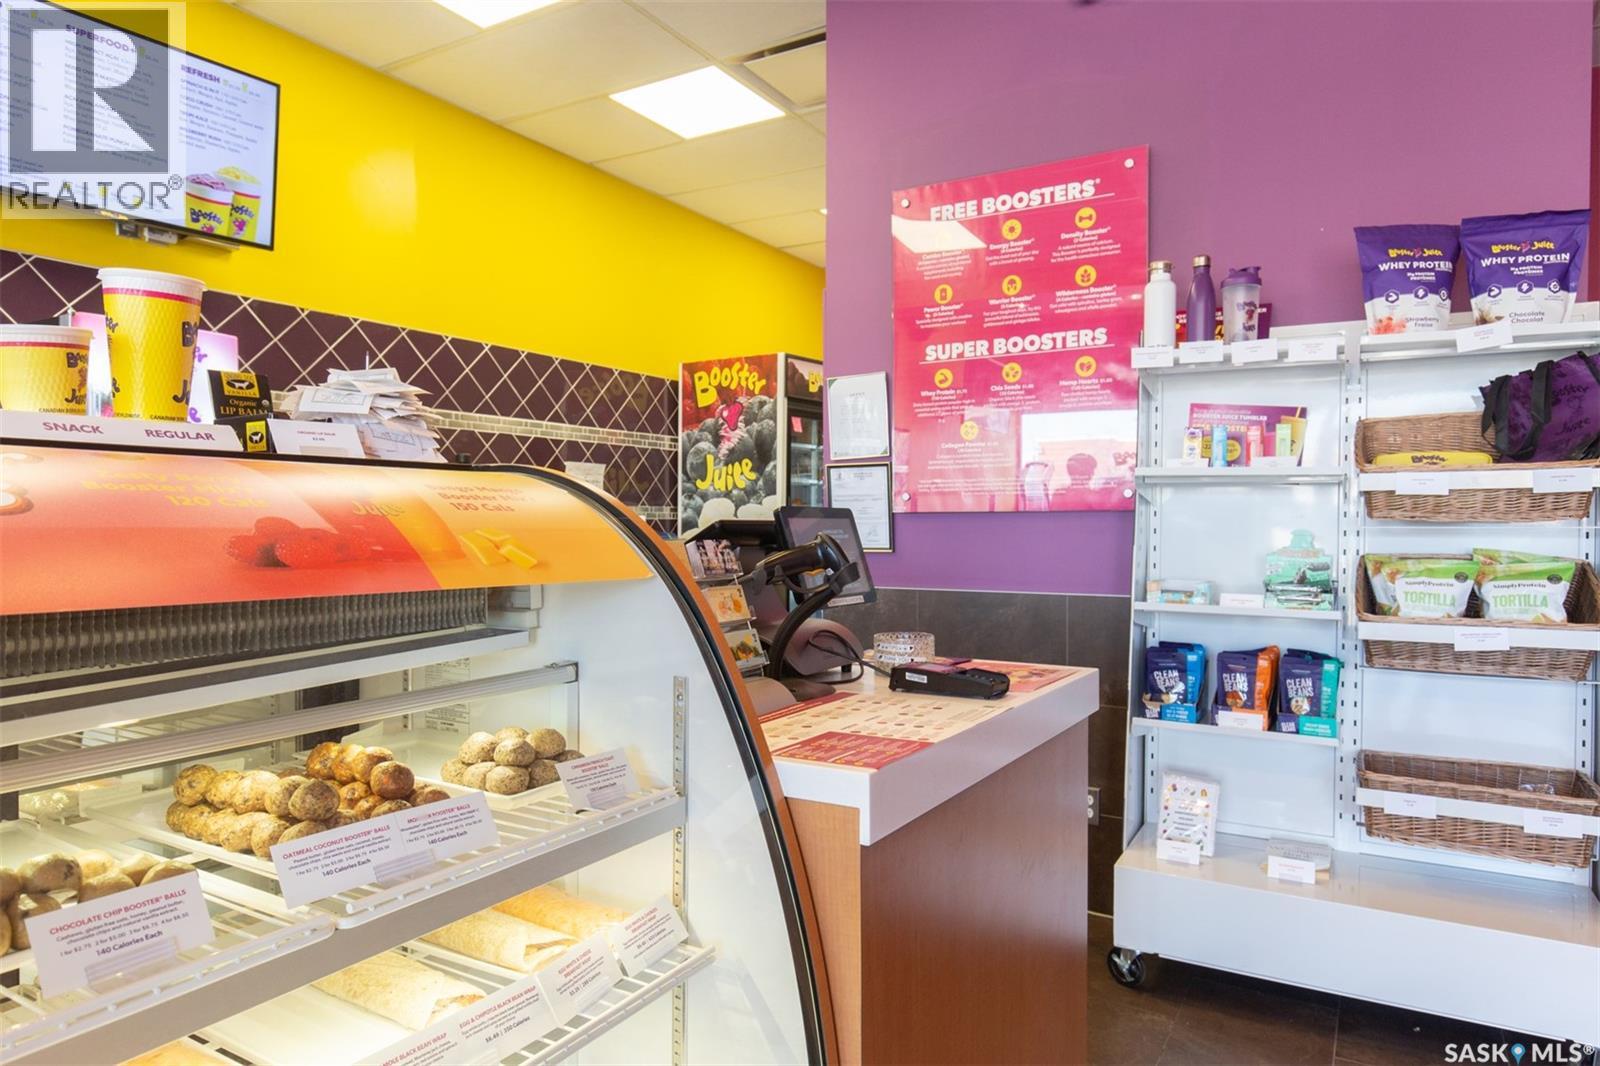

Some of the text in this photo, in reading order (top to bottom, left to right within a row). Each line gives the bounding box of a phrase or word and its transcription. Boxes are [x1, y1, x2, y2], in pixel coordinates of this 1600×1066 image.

[65, 24, 129, 52] SUPERFOOD
[181, 64, 221, 83] REFRESH
[930, 201, 977, 223] FREE
[1378, 260, 1412, 272] WHEY
[1481, 252, 1570, 268] WHEY PROTEIN
[1056, 289, 1089, 298] Wilderness
[1509, 310, 1545, 320] Chocolate
[1511, 317, 1544, 325] Chocolat
[925, 327, 1109, 361] SUPER BOOSTERS
[694, 361, 767, 408] Booster
[230, 399, 257, 407] Organic
[220, 406, 237, 415] LIP
[42, 421, 104, 435] SNACK
[144, 428, 216, 442] REGULAR
[696, 454, 757, 492] Juice
[449, 501, 515, 514] 150 Cals
[1492, 582, 1547, 591] SimplyProtein
[1404, 590, 1457, 608] TORTILLA
[1492, 593, 1549, 609] TORTILLA
[1153, 669, 1179, 680] CLEAN
[1222, 672, 1248, 683] CLEAN
[1224, 682, 1249, 693] BEANS
[1285, 677, 1313, 689] CLEAN
[1287, 686, 1314, 698] BEANS
[282, 846, 313, 859] OATMEAL
[313, 837, 344, 850] COCONUT
[373, 823, 390, 833] BALLS
[438, 834, 457, 843] Calories
[457, 830, 468, 838] Each
[321, 856, 371, 876] 140 Calories Each
[48, 913, 102, 936] CHOCOLATE
[102, 907, 124, 919] CHIP
[163, 889, 186, 900] BALLS
[66, 932, 95, 945] chocolate
[95, 927, 110, 936] chips
[95, 929, 163, 956] 140 Calories Each
[458, 1019, 471, 1028] EGG
[496, 998, 512, 1009] BLACK
[512, 1015, 531, 1028] Calories
[398, 1031, 447, 1060] BLACK BEAN WRAP
